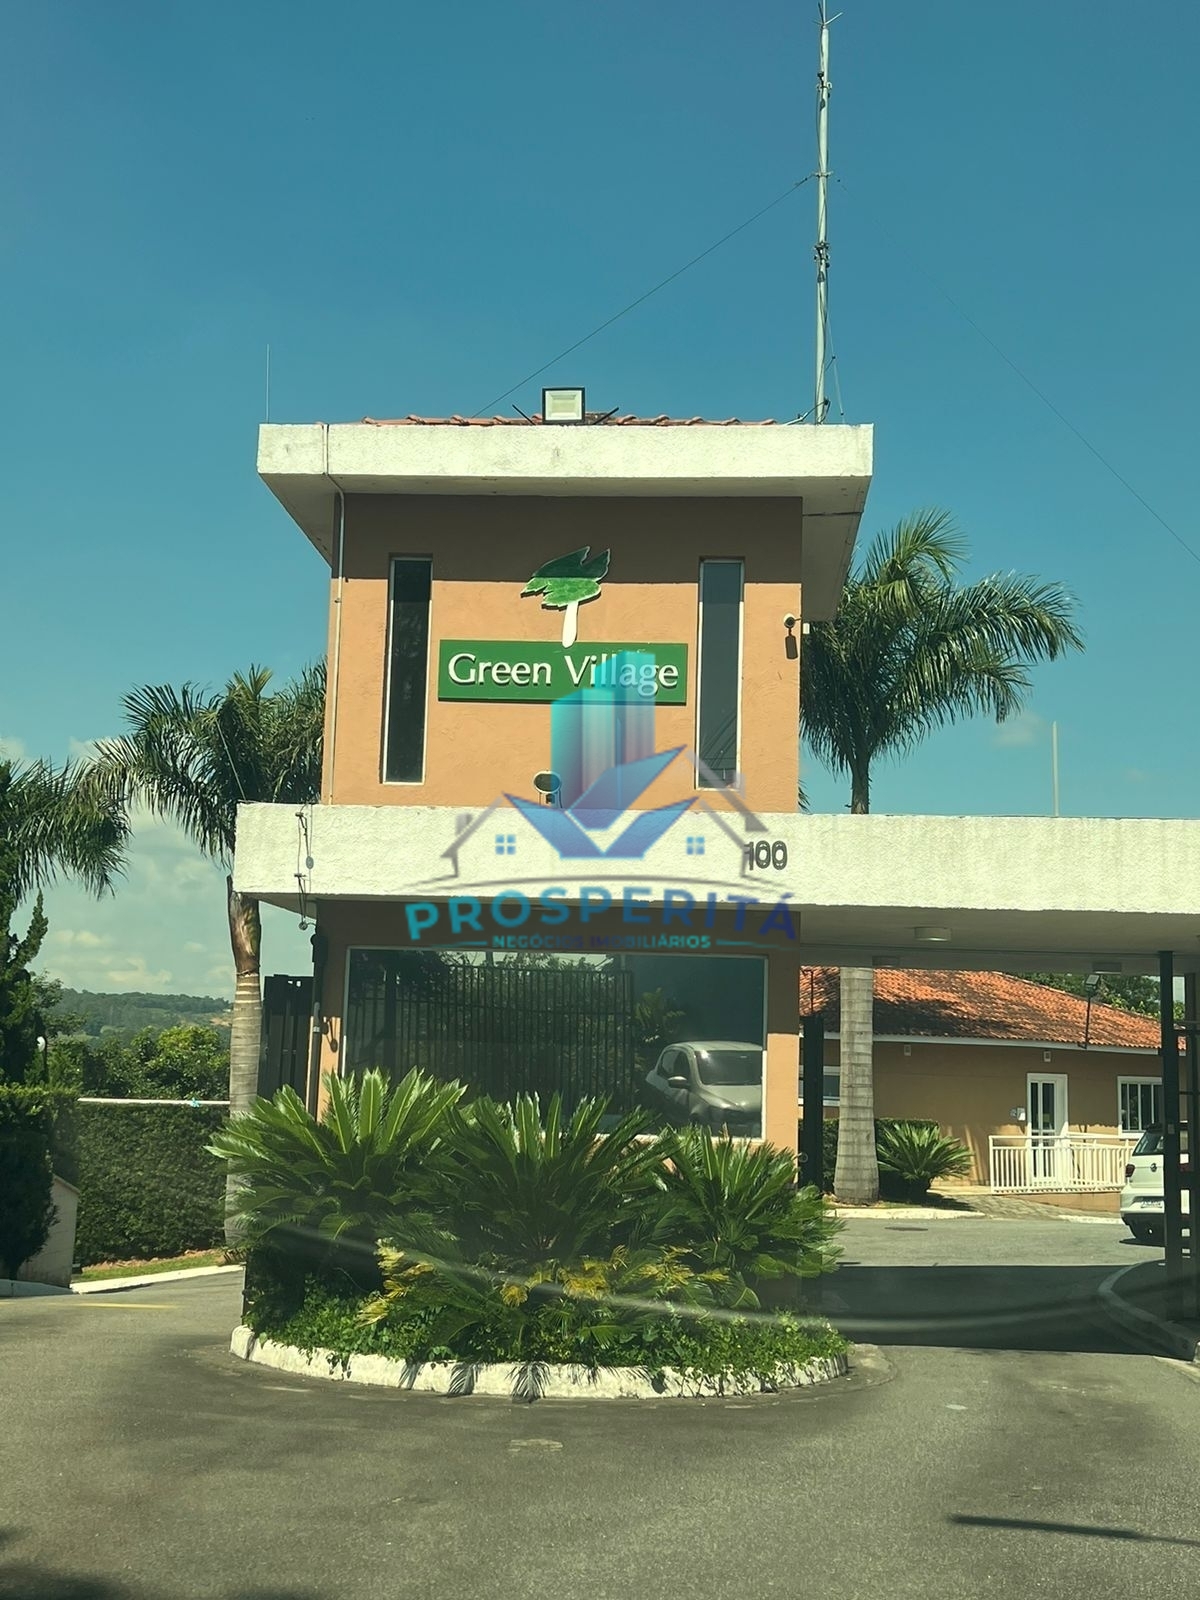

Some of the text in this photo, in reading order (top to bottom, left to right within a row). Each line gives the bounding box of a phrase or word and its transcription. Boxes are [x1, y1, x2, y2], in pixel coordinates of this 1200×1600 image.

[448, 652, 679, 697] Green Village
[746, 840, 788, 871] 100
